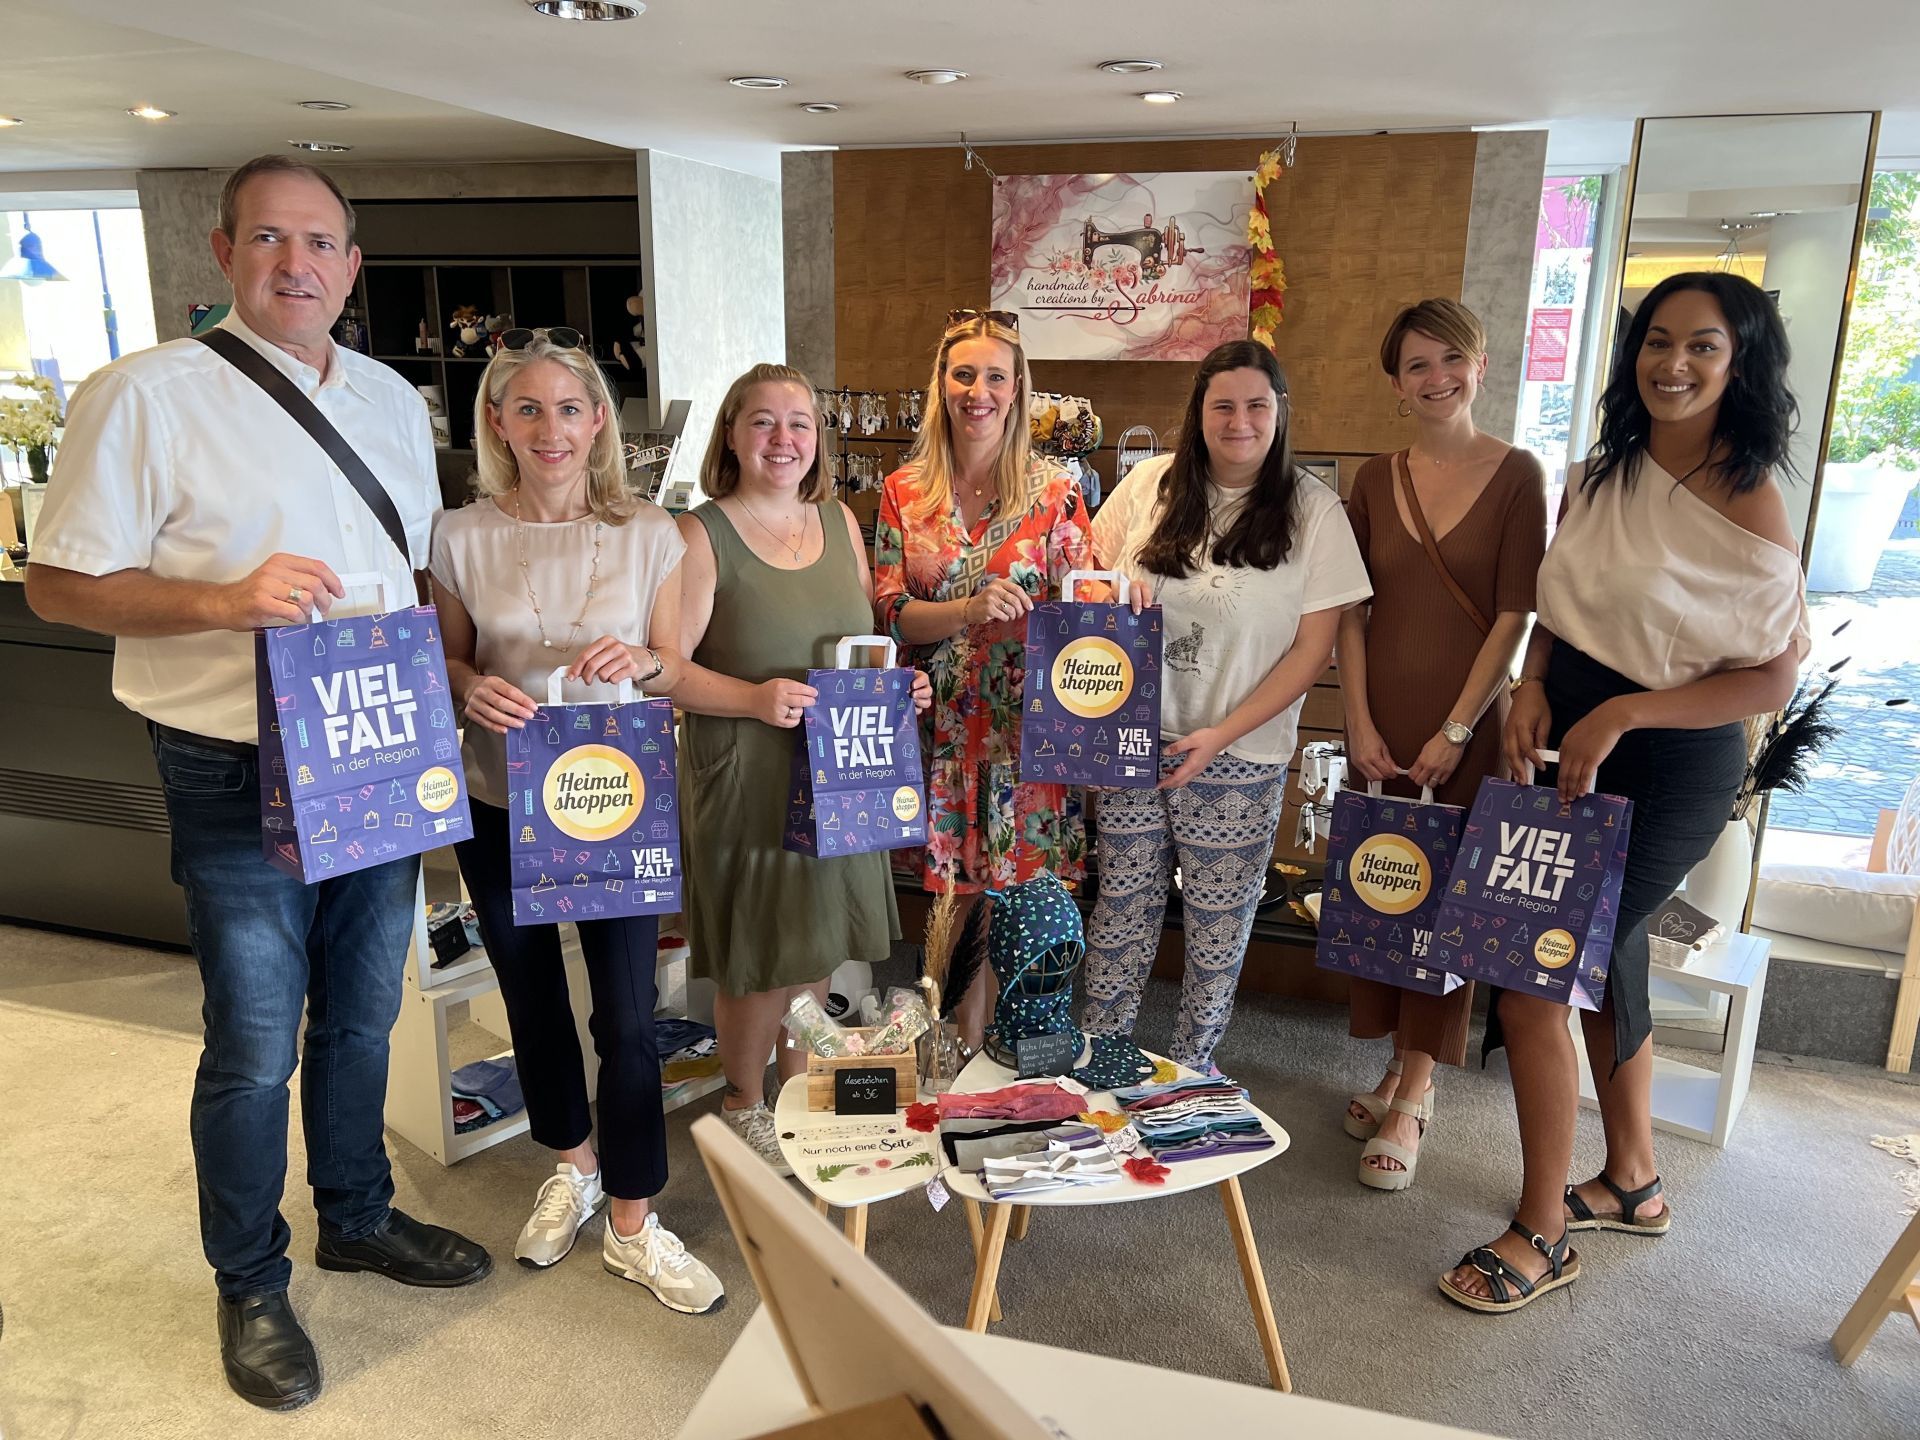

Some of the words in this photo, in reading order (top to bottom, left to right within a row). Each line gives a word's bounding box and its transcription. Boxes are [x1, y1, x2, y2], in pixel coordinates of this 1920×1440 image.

[1027, 276, 1089, 292] handmade
[1035, 292, 1087, 304] creations
[1091, 290, 1105, 306] by
[1107, 270, 1202, 325] Sabrina
[636, 450, 653, 459] CITY
[1063, 658, 1122, 676] Heimat
[311, 662, 414, 716] VIEL
[1059, 675, 1124, 695] shoppen
[323, 702, 418, 758] FALT
[830, 706, 894, 737] VIEL
[1118, 728, 1152, 742] VIEL
[834, 736, 894, 768] FALT
[1118, 742, 1152, 756] FALT
[333, 762, 345, 775] in
[349, 756, 371, 773] der
[374, 745, 420, 767] Region
[556, 772, 630, 792] Heimat
[838, 772, 846, 780] in
[849, 770, 863, 780] der
[866, 768, 896, 780] Region
[422, 778, 451, 791] Heimat
[422, 787, 454, 801] shoppen
[554, 792, 634, 814] shoppen
[1500, 821, 1576, 869] VIEL
[632, 848, 672, 865] VIEL
[1362, 852, 1420, 876] Heimat
[634, 863, 674, 878] FALT
[1486, 854, 1574, 902] FALT
[1356, 870, 1421, 892] shoppen
[1482, 889, 1494, 900] in
[1497, 892, 1515, 906] der
[1518, 896, 1558, 915] Region
[1413, 928, 1433, 944] VI
[1542, 938, 1572, 950] Heimat
[1412, 942, 1428, 957] FA
[1538, 946, 1570, 958] shoppen
[864, 1088, 879, 1100] 3€
[825, 1145, 851, 1153] noch
[855, 1143, 876, 1151] eine
[879, 1138, 914, 1152] Seite
